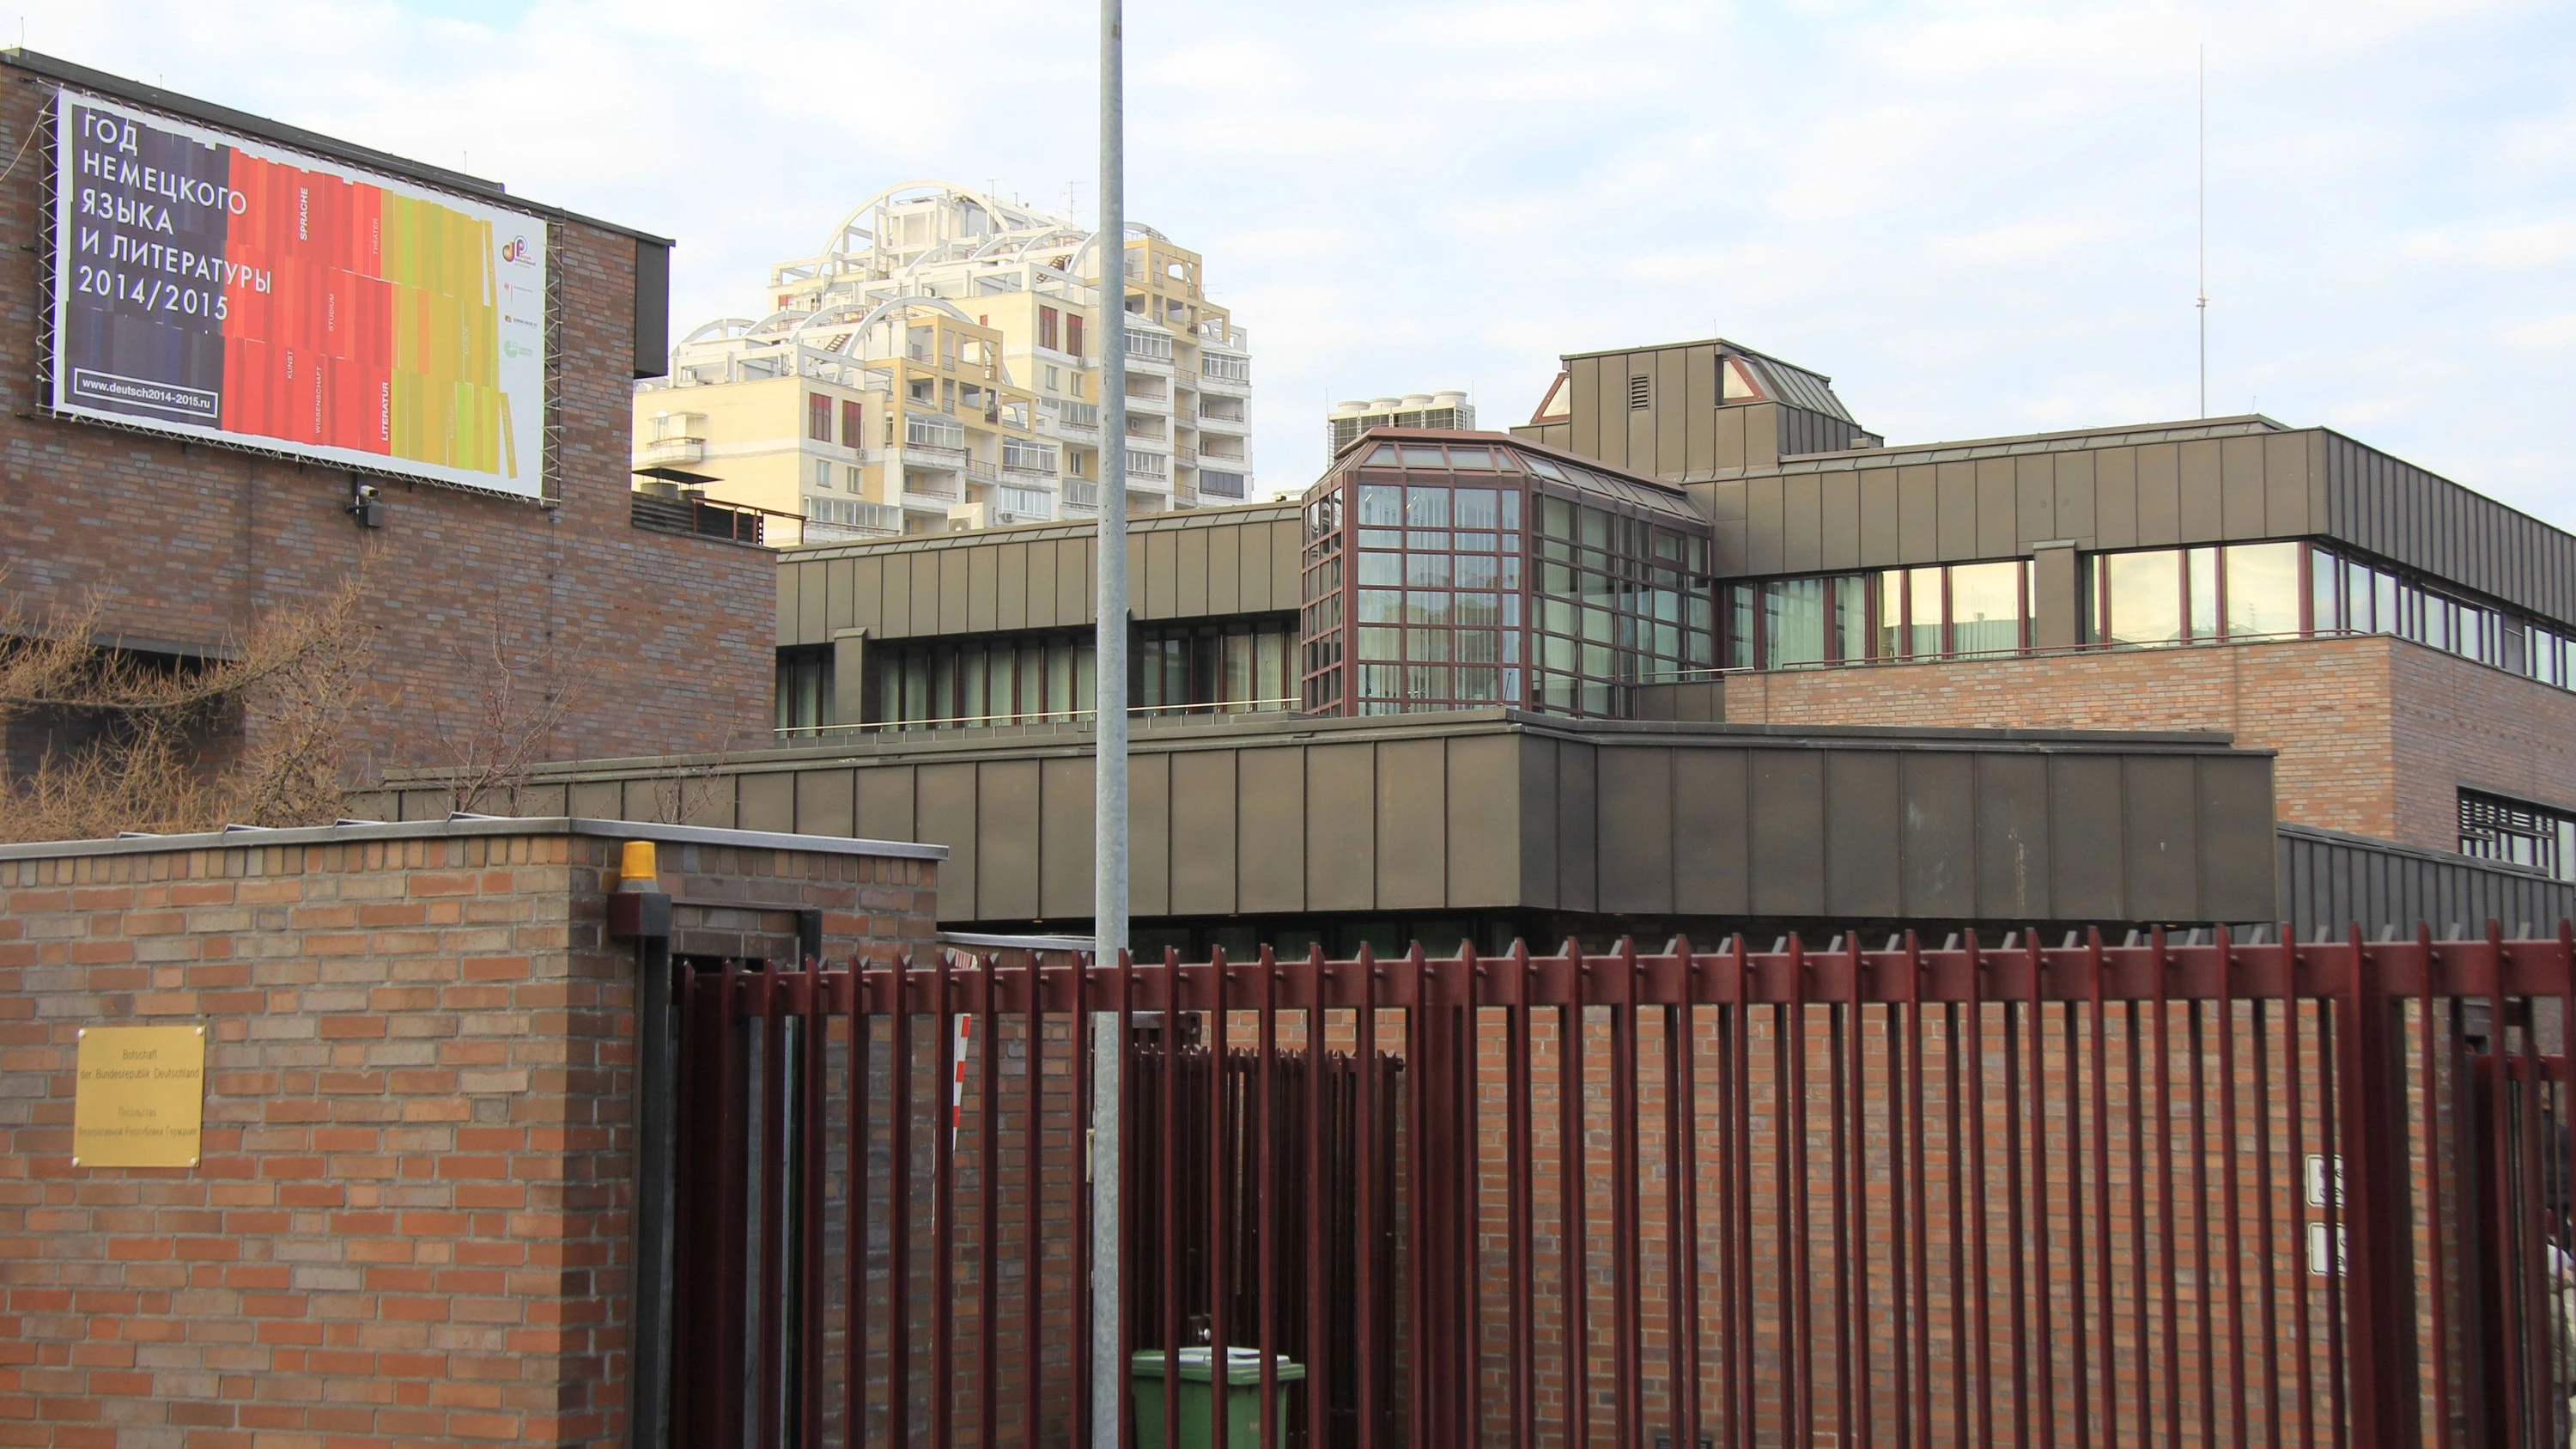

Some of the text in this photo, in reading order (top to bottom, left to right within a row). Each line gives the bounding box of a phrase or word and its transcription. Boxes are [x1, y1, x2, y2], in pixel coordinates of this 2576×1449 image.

[85, 113, 138, 156] ГОД
[83, 149, 247, 215] НЕМЕЦКОГО
[82, 188, 174, 235] ЯЗЫКА
[300, 187, 308, 241] SPRACHE
[82, 227, 271, 295] И ЛИТЕРАТУРЫ
[78, 265, 228, 321] 2014/2015
[82, 378, 211, 409] www.deutsch2014-2015.ru
[80, 1068, 200, 1081] der Bundesrepublik Deutschland
[122, 1049, 158, 1061] Botschaft
